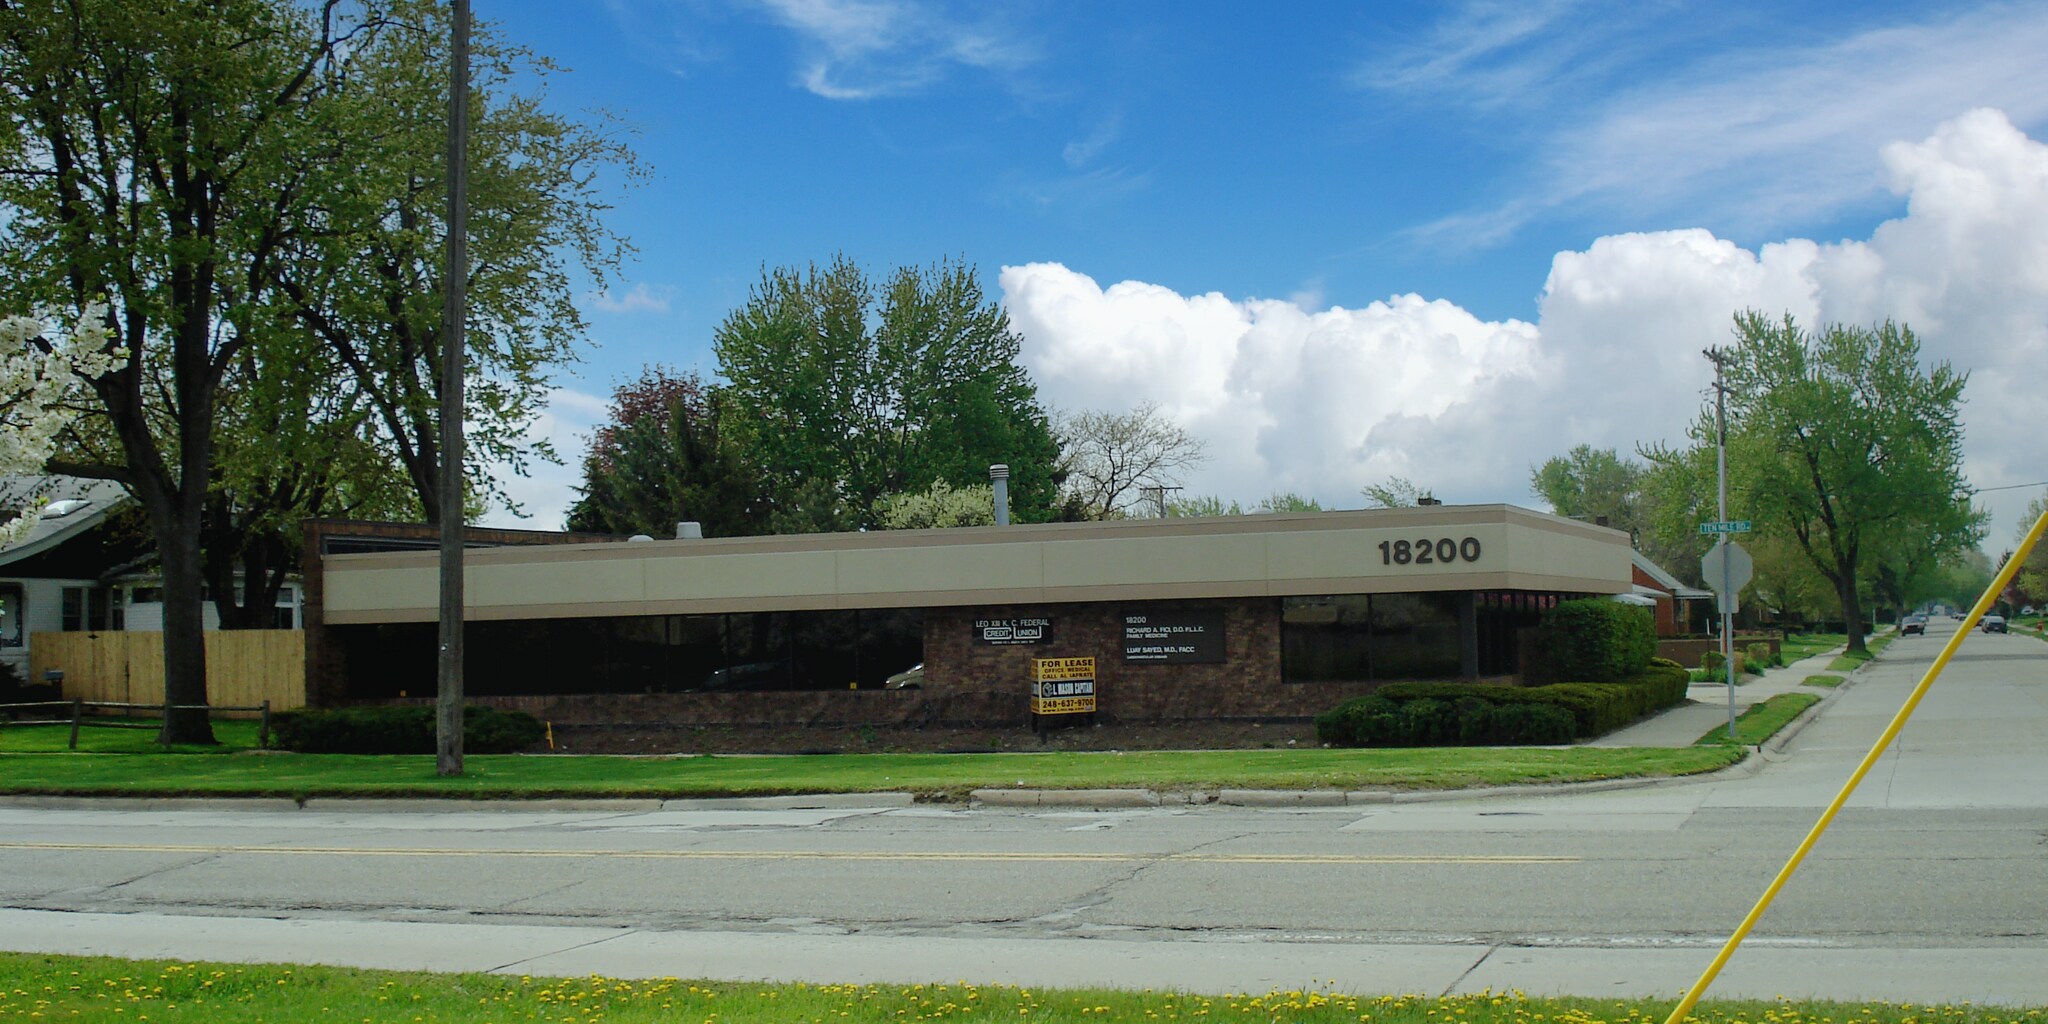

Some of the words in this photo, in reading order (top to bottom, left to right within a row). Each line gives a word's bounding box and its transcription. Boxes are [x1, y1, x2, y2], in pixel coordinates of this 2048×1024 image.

[1379, 537, 1481, 565] 18200
[976, 620, 989, 628] LEO
[1126, 616, 1147, 624] 18200
[1042, 660, 1060, 668] FOR
[1065, 659, 1093, 667] LEASE
[1042, 698, 1095, 709] 248-637-9700
